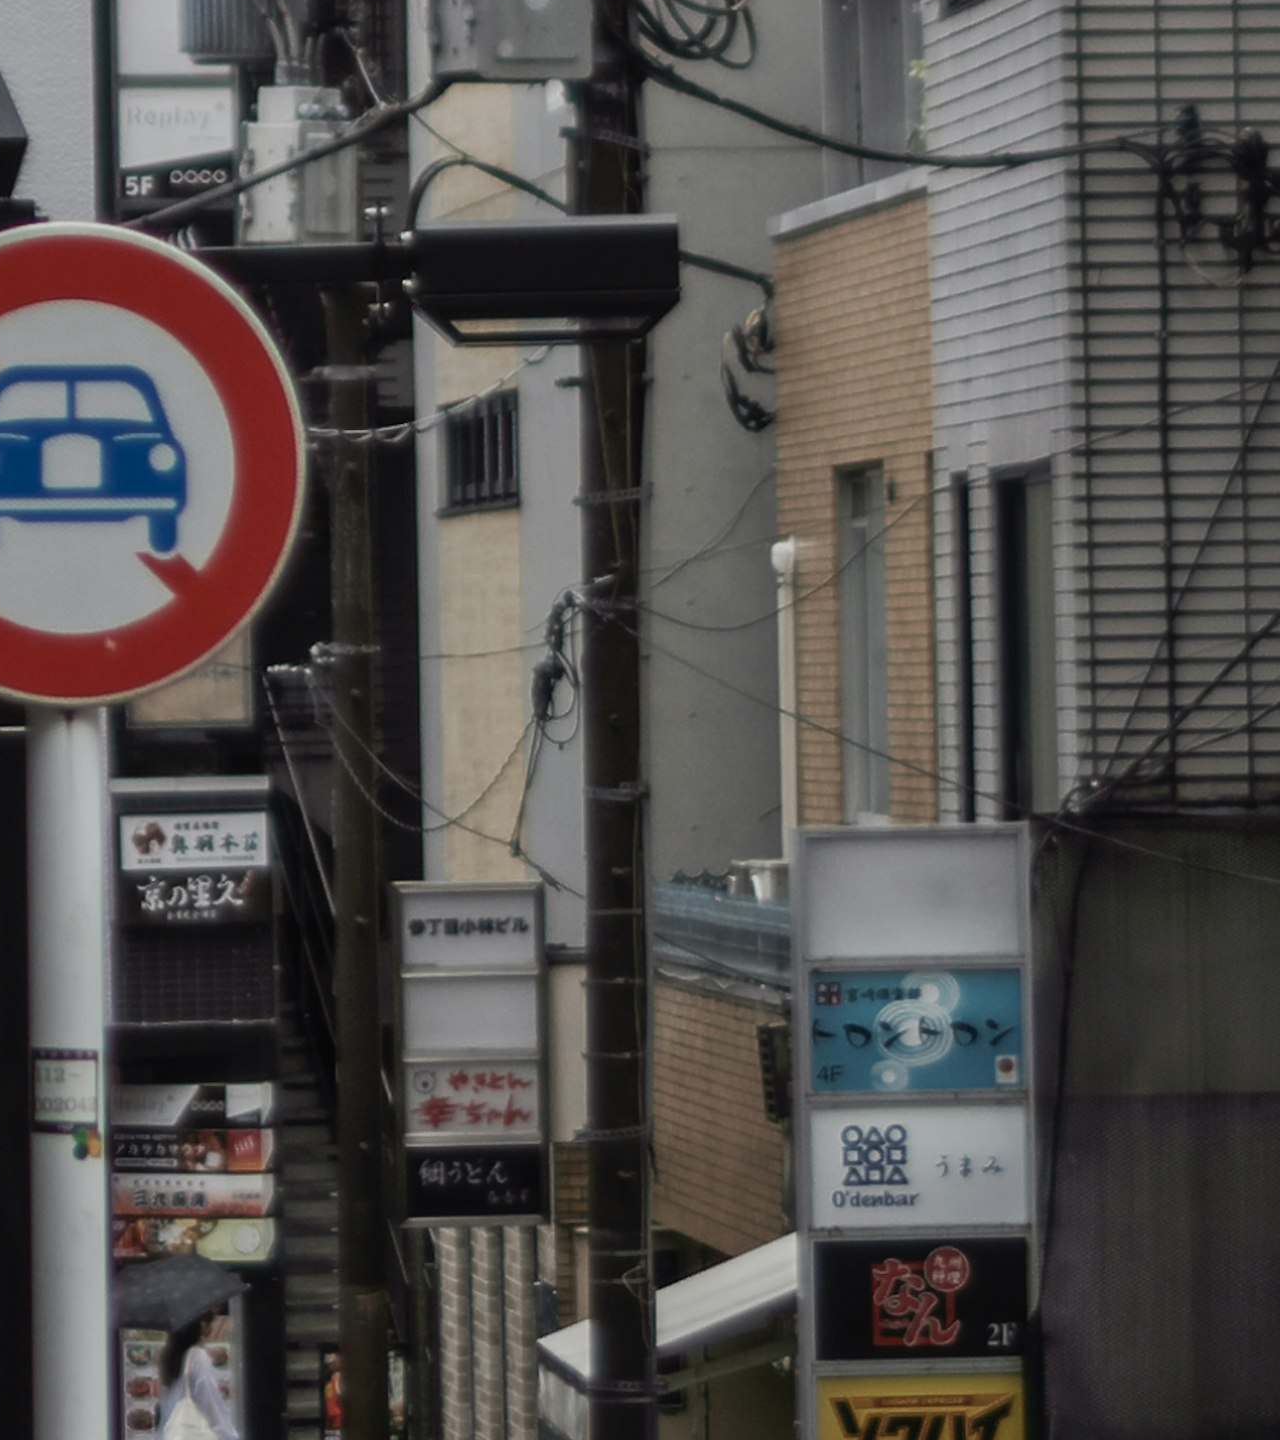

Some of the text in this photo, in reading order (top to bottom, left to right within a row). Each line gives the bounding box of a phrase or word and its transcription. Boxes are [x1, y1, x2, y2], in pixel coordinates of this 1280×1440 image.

[125, 175, 154, 195] 5F
[812, 1017, 1016, 1050] トロントロン
[816, 1065, 844, 1083] 4F
[935, 1154, 1005, 1177] うまみ
[832, 1190, 919, 1209] O'denbar
[872, 1258, 961, 1347] なん
[987, 1321, 1018, 1347] 2F
